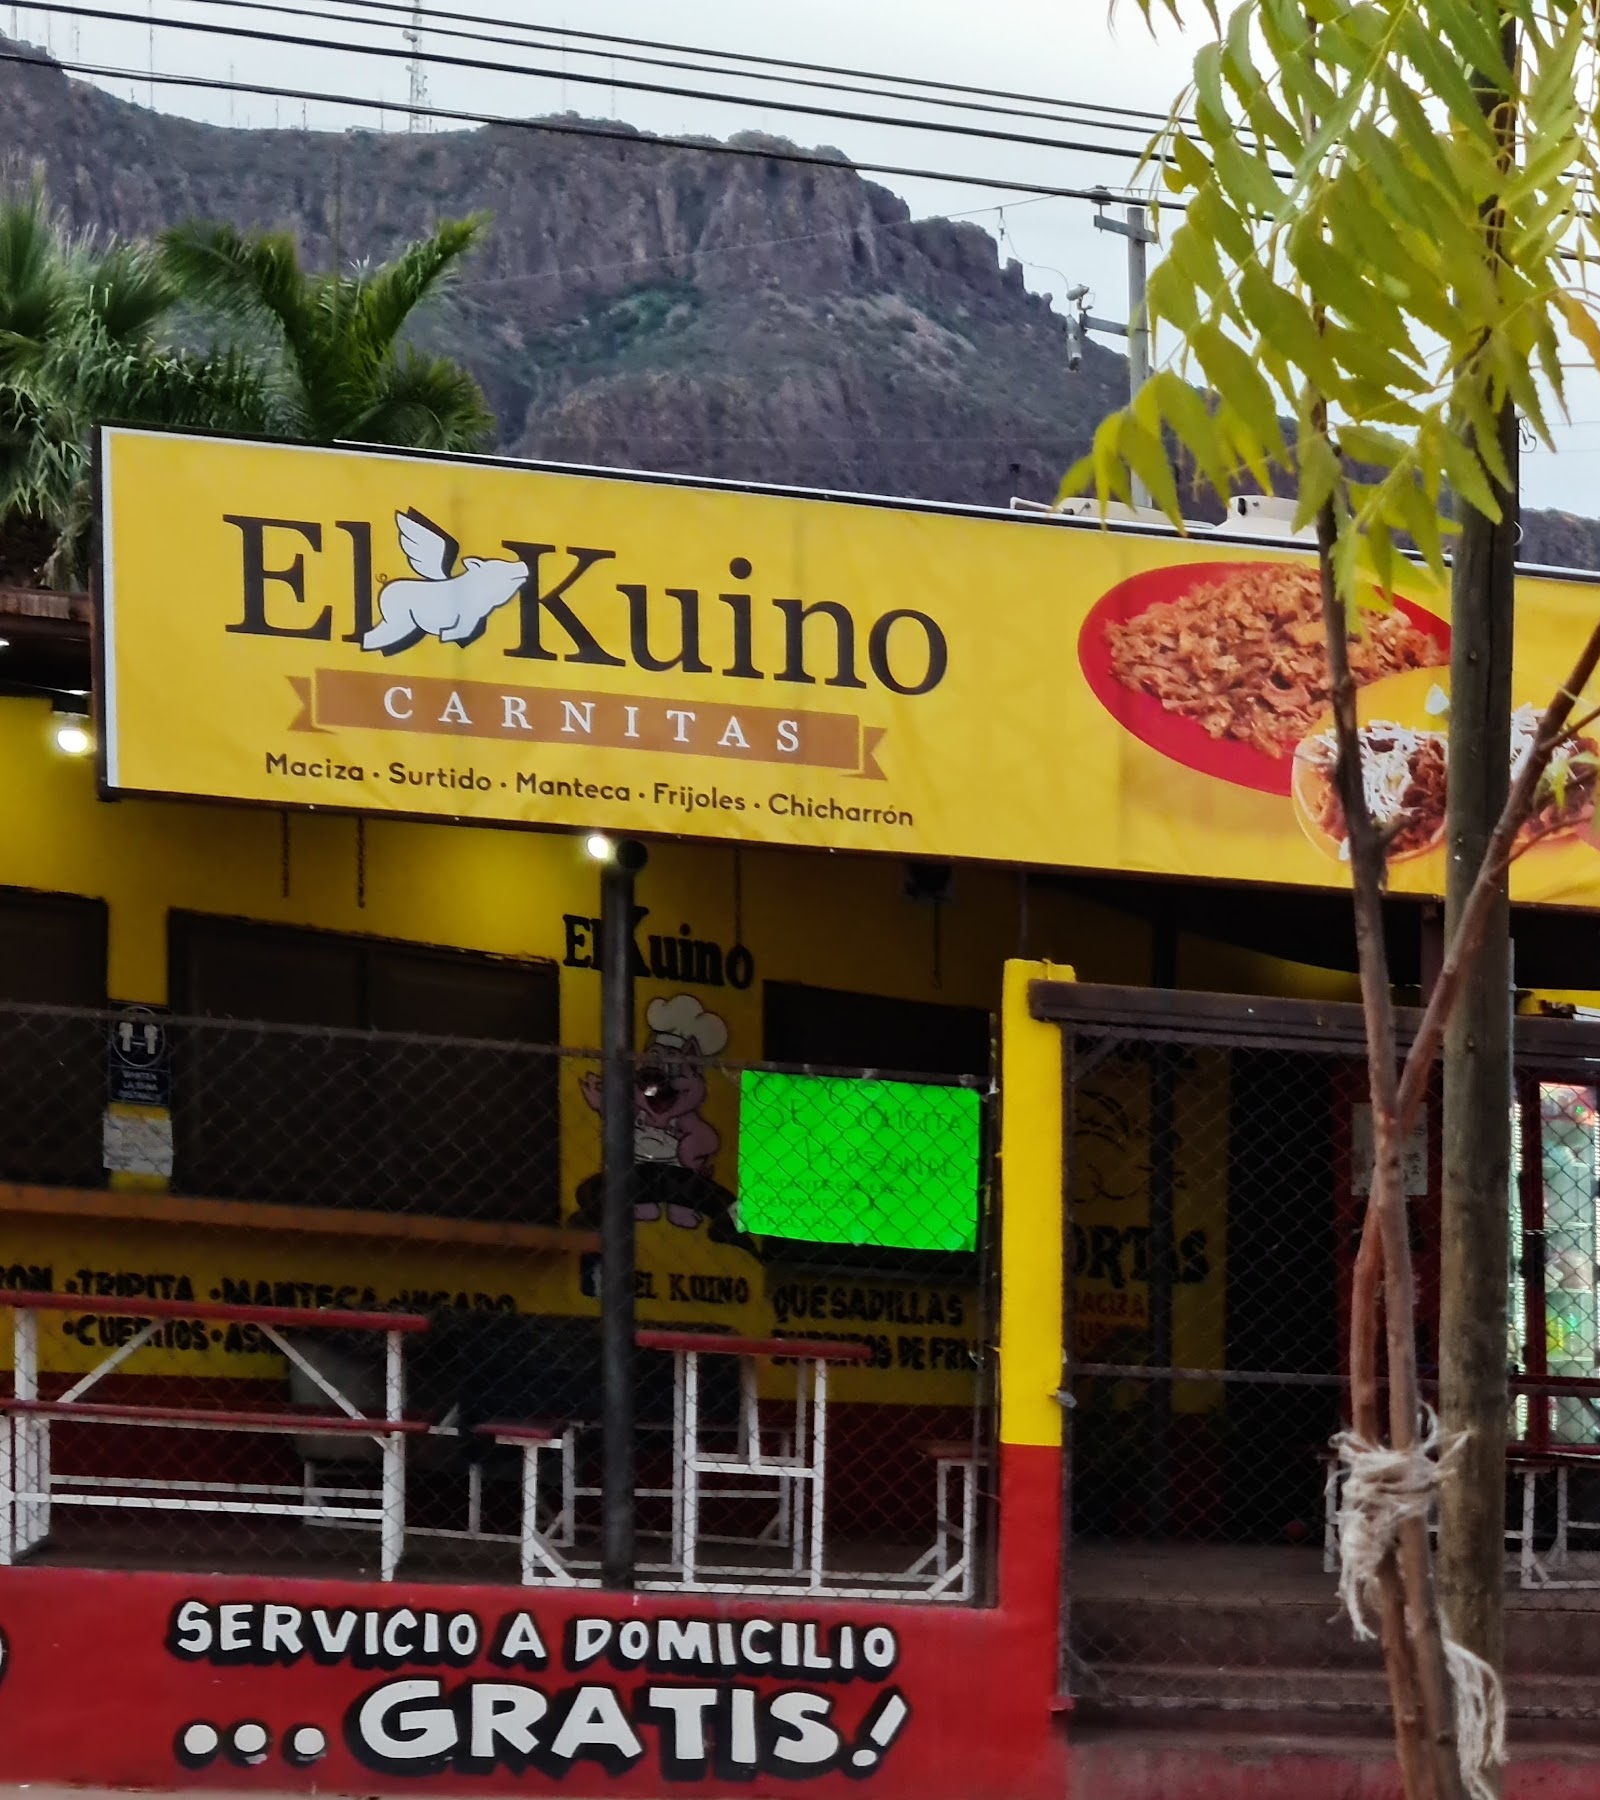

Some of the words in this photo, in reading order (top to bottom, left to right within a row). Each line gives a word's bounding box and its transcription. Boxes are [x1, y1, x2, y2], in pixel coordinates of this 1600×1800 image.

[222, 512, 374, 645] El
[501, 538, 950, 697] Kuino
[382, 685, 802, 753] CARNITAS
[265, 752, 364, 782] Maciza
[388, 762, 492, 791] Surtido
[516, 772, 631, 803] Manteca
[653, 782, 746, 814] Frijoles
[768, 793, 914, 827] Chicharrón
[668, 1272, 750, 1305] KUINO
[773, 1284, 964, 1326] QUESADILLAS
[174, 1599, 479, 1660] SERVICIO
[500, 1611, 549, 1661] A
[573, 1617, 898, 1672] DOMICILIO
